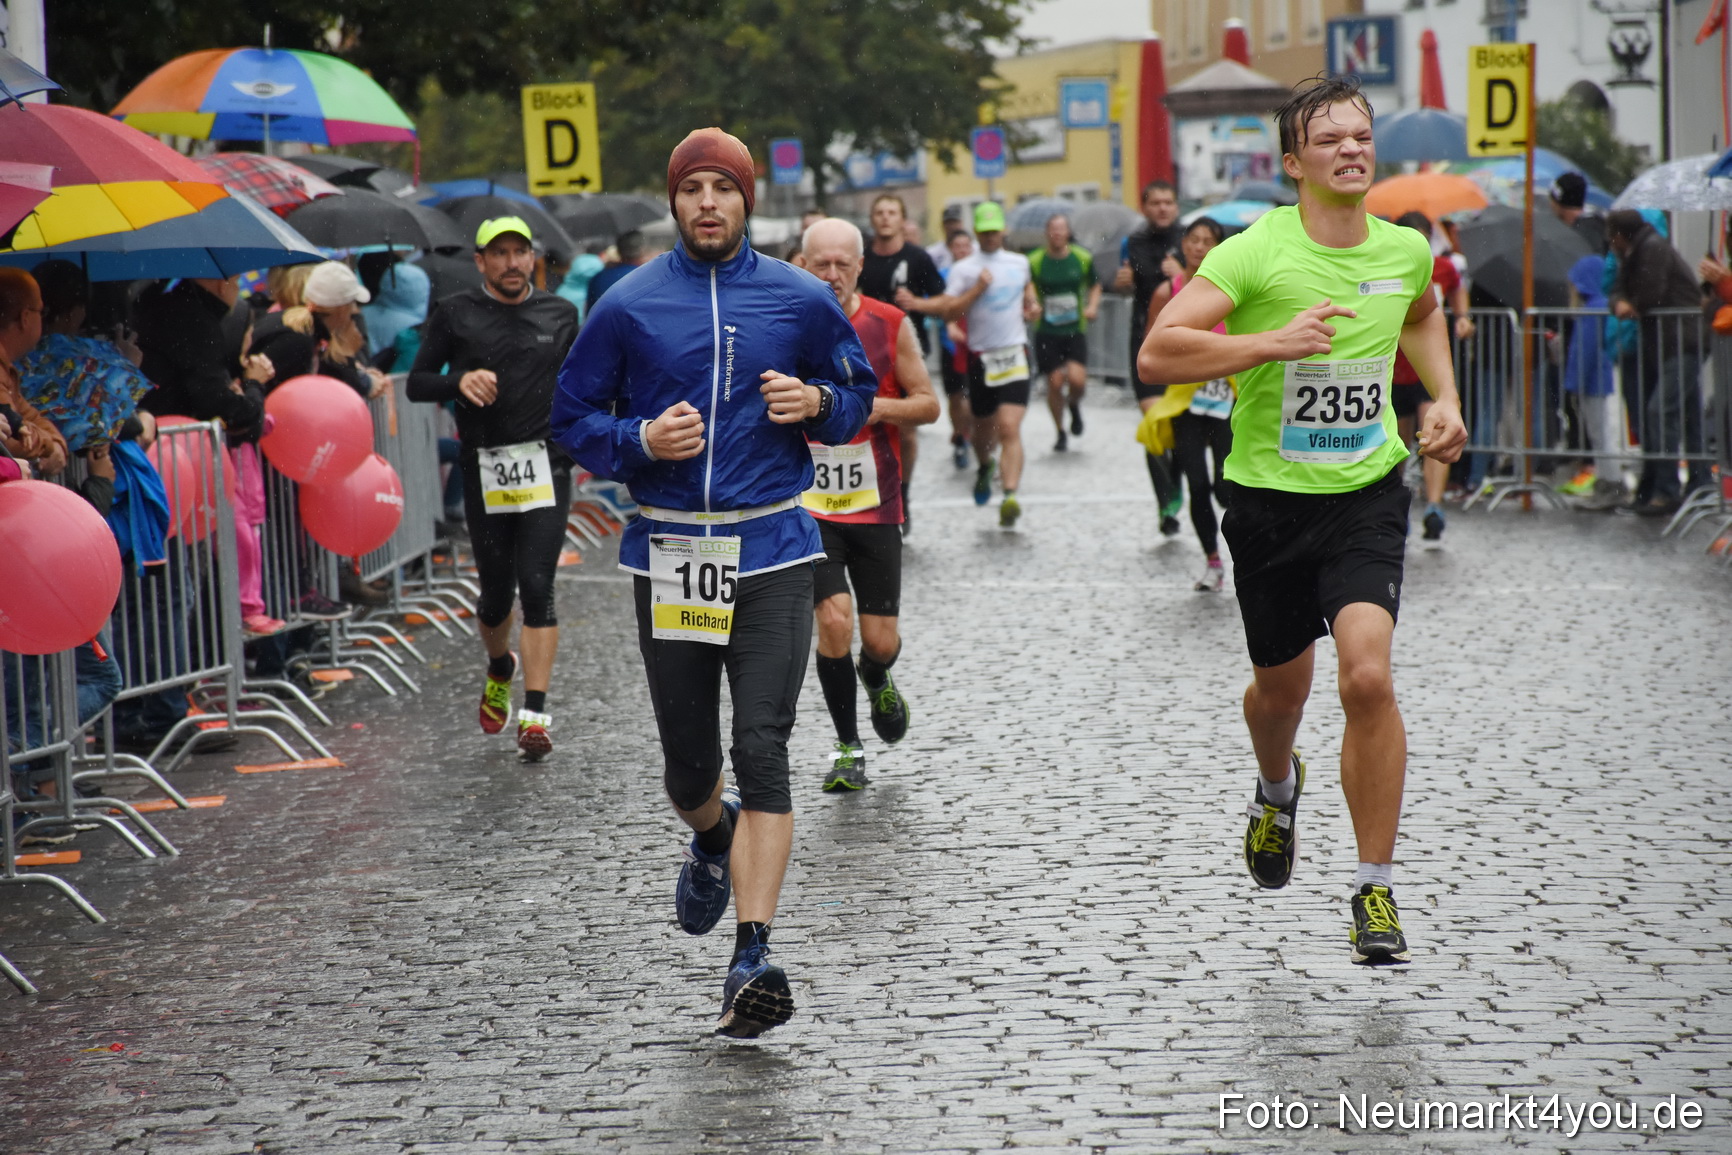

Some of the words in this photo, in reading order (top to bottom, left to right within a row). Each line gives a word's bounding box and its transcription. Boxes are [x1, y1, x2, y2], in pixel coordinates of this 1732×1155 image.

[532, 89, 586, 111] Block
[1486, 78, 1518, 128] D
[544, 119, 579, 168] D
[1295, 371, 1331, 379] NeuerMarkt
[1337, 362, 1382, 376] BOCK
[1295, 383, 1382, 424] 2353
[1309, 433, 1364, 449] Valentin
[495, 460, 536, 486] 344
[816, 463, 863, 491] 315
[827, 497, 852, 509] Peter
[675, 561, 737, 604] 105
[681, 610, 728, 630] Richard
